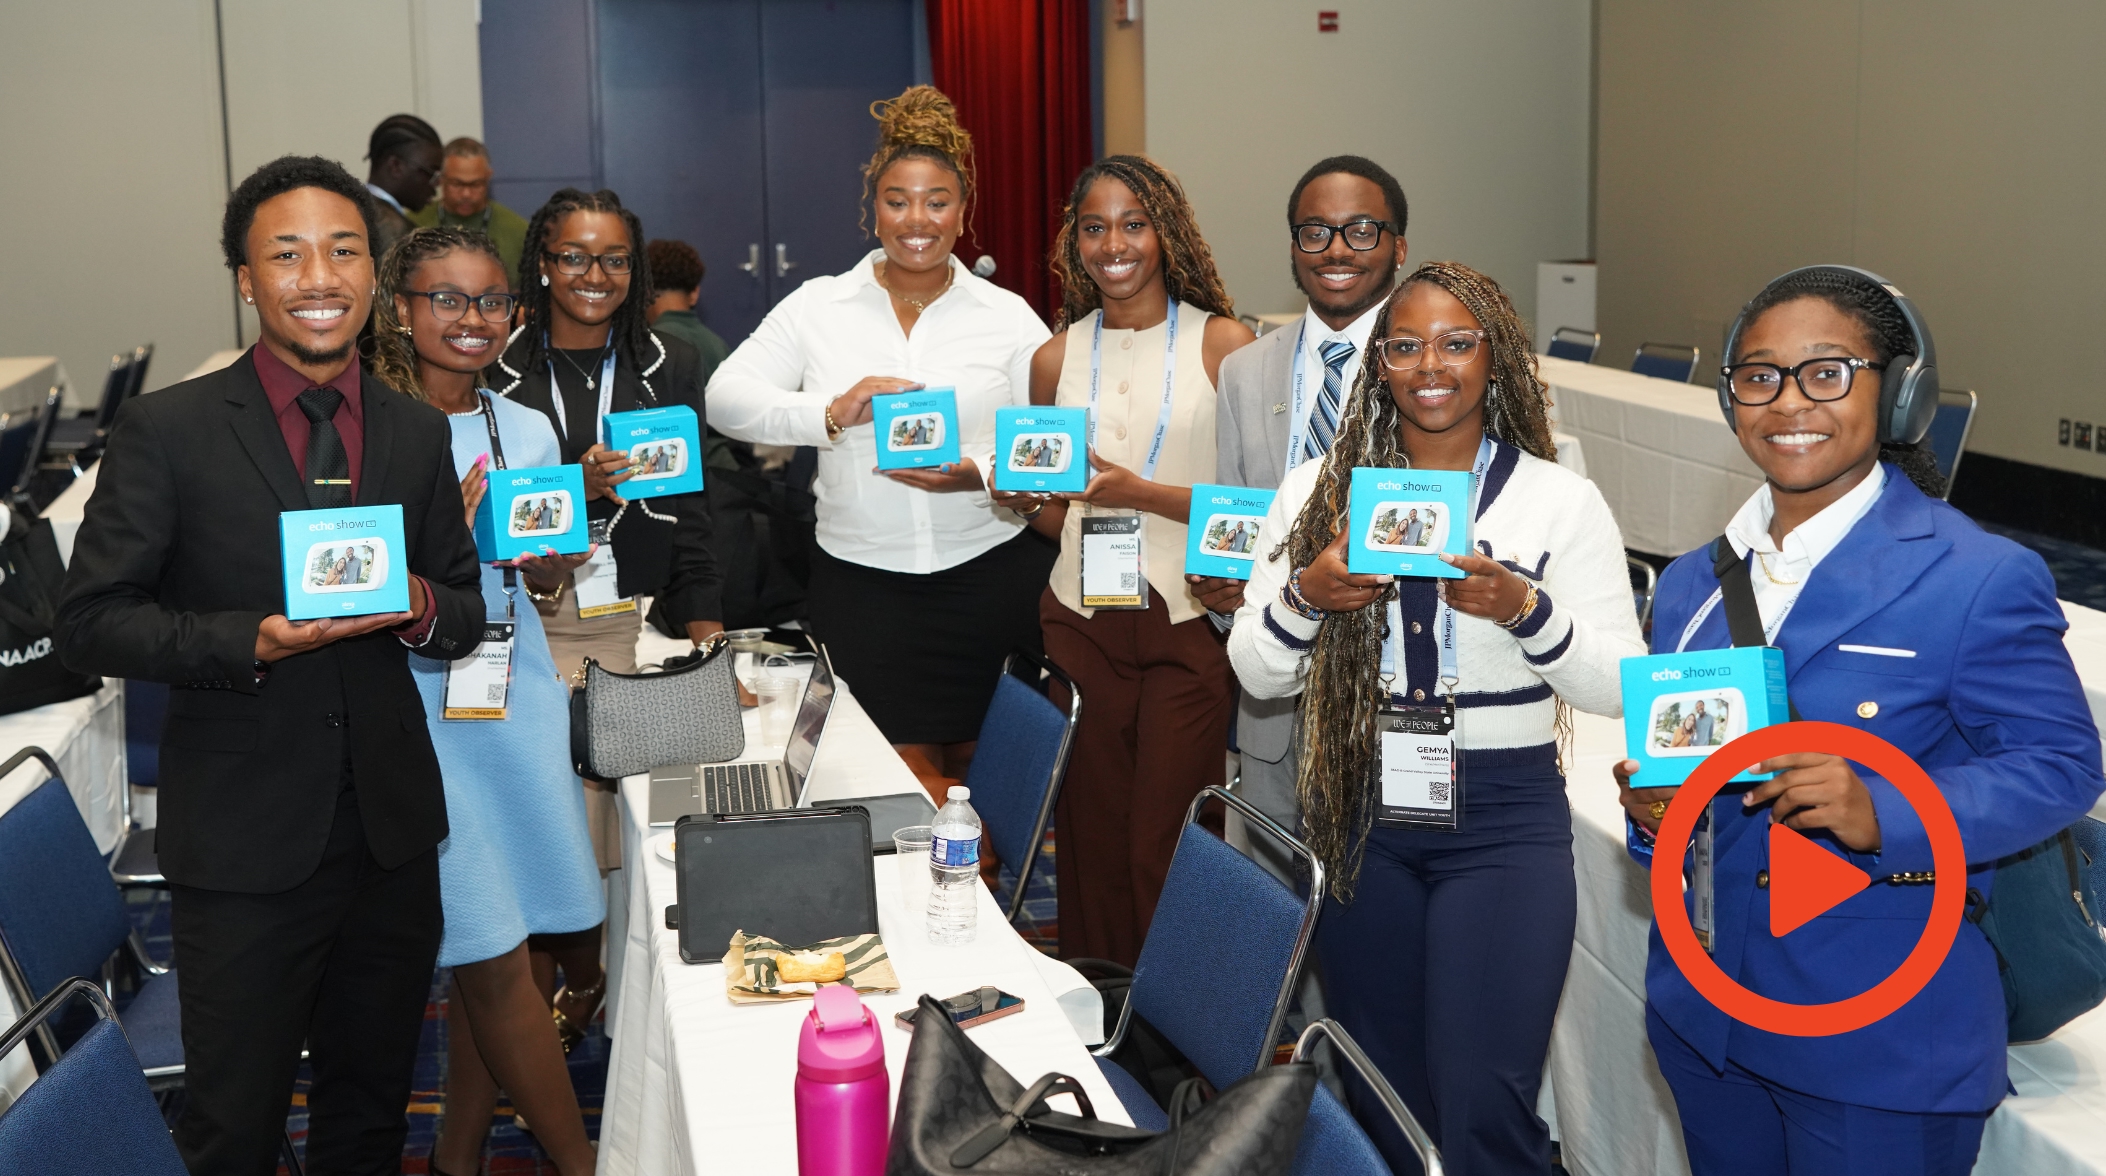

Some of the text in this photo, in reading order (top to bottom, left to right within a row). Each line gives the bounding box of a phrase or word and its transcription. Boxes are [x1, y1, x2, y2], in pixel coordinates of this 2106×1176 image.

[1163, 370, 1172, 404] JPMorganChase
[1295, 373, 1303, 414] JPMorganChase
[891, 400, 928, 410] echo show
[1015, 417, 1057, 426] echo show
[630, 426, 671, 437] echo show
[1148, 424, 1165, 465] JPMorganChase
[511, 476, 555, 486] echo show
[1377, 480, 1431, 492] echo show
[1211, 496, 1256, 507] echo show
[309, 519, 365, 532] echo show
[1651, 667, 1717, 682] echo show
[1412, 720, 1439, 731] PEOPLE
[1416, 746, 1449, 754] GEMYA
